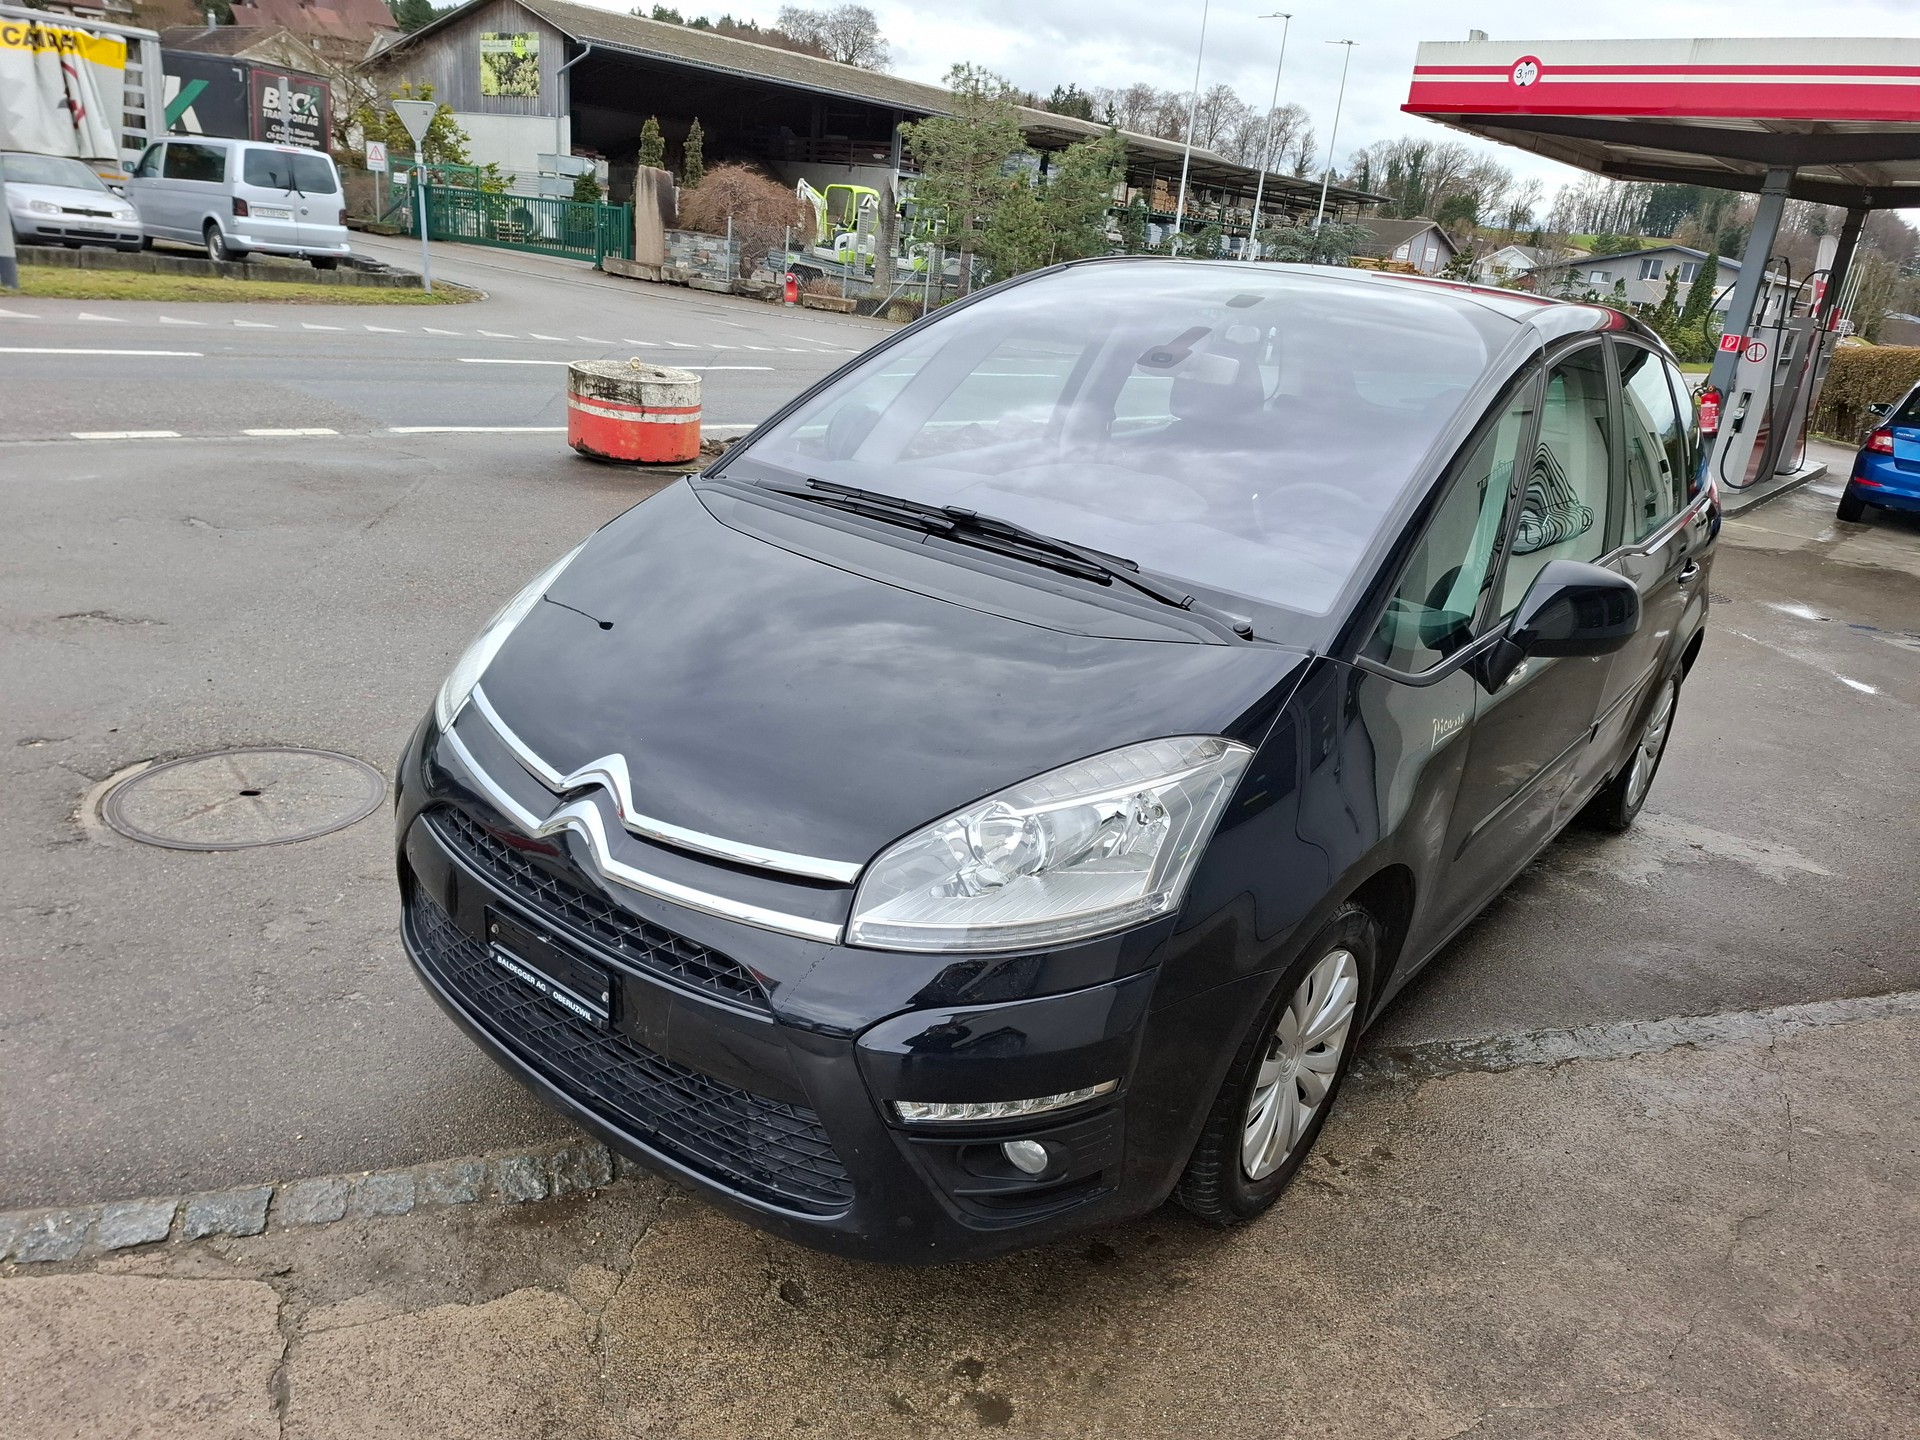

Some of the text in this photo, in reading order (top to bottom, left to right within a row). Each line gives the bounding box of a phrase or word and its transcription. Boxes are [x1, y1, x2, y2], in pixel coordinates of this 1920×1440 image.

[262, 108, 319, 126] TRAORT AG
[263, 86, 319, 117] BCK
[497, 955, 592, 1022] BALDEGGER AG OBERUZWIL
